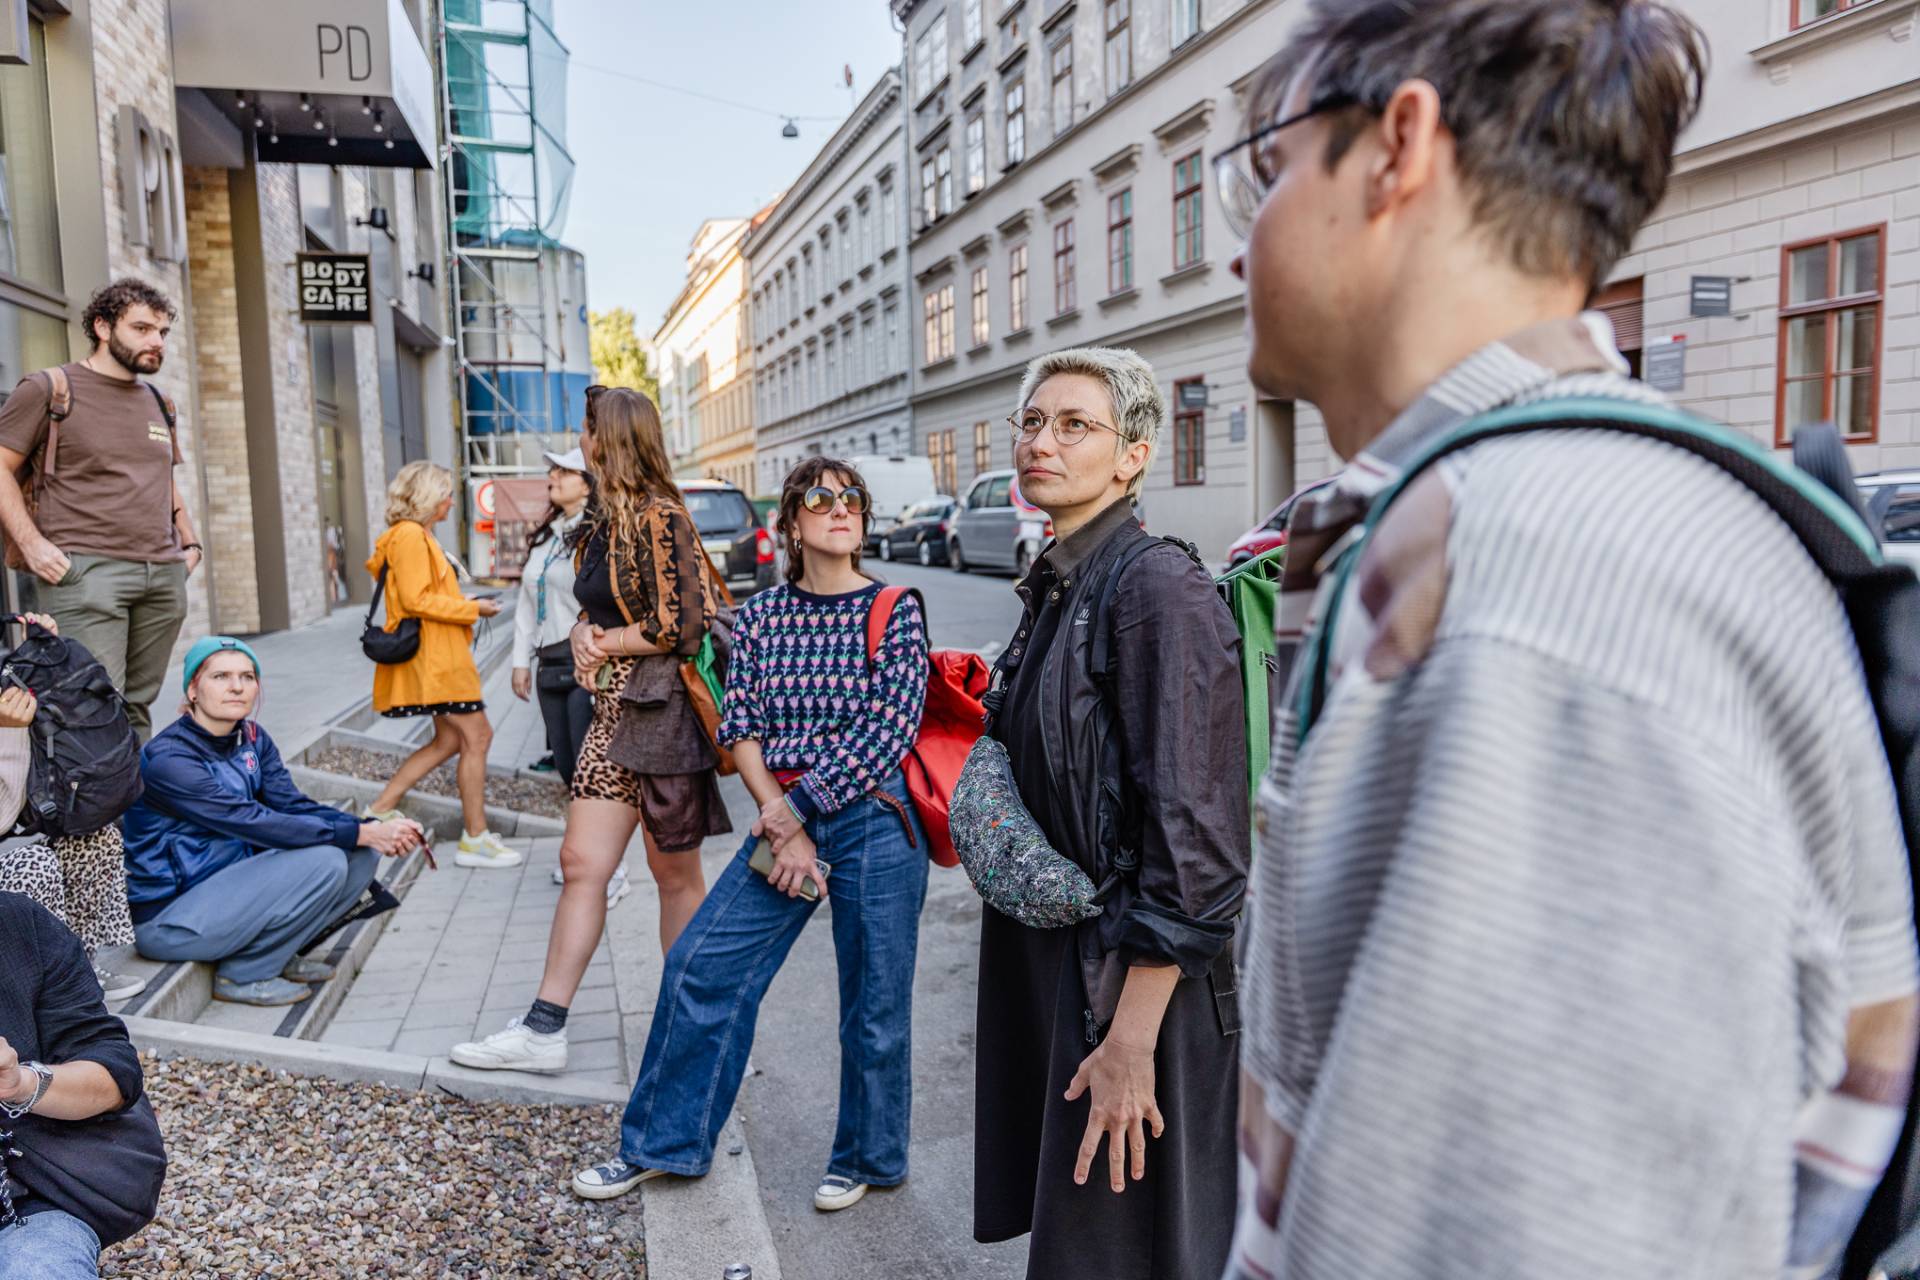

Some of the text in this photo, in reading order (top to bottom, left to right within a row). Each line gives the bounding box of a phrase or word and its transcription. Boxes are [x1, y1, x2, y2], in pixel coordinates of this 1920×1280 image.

[317, 24, 371, 81] PD
[302, 262, 366, 287] BODY
[304, 287, 367, 311] CARE
